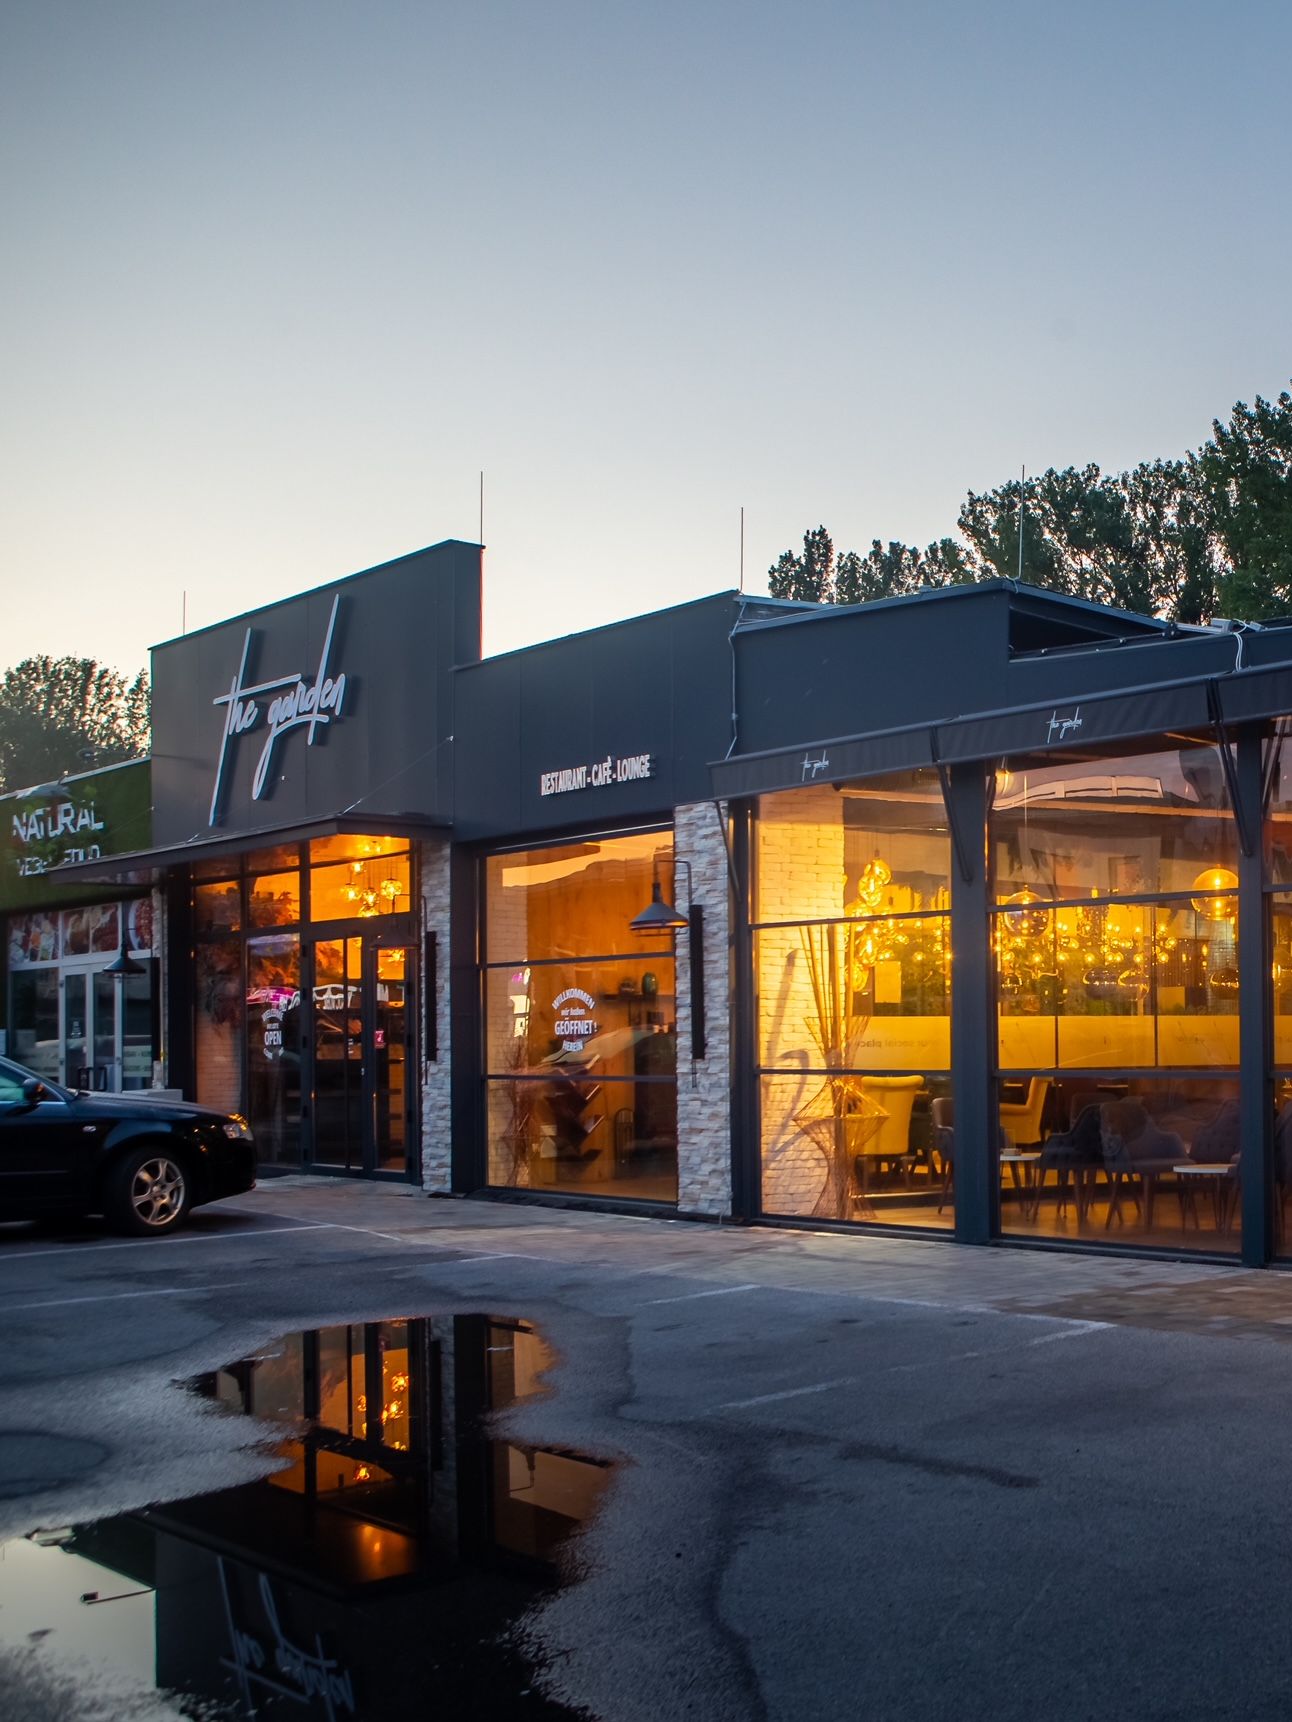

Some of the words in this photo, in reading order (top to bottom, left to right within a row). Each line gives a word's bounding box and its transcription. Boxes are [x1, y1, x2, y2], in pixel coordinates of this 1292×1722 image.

[252, 593, 346, 800] garden
[541, 766, 587, 796] RESTAURANT
[617, 754, 650, 782] LOUNGE
[13, 801, 104, 841] NATURAL
[552, 988, 595, 1010] WILLKOMMEN
[264, 1030, 282, 1046] OPEN
